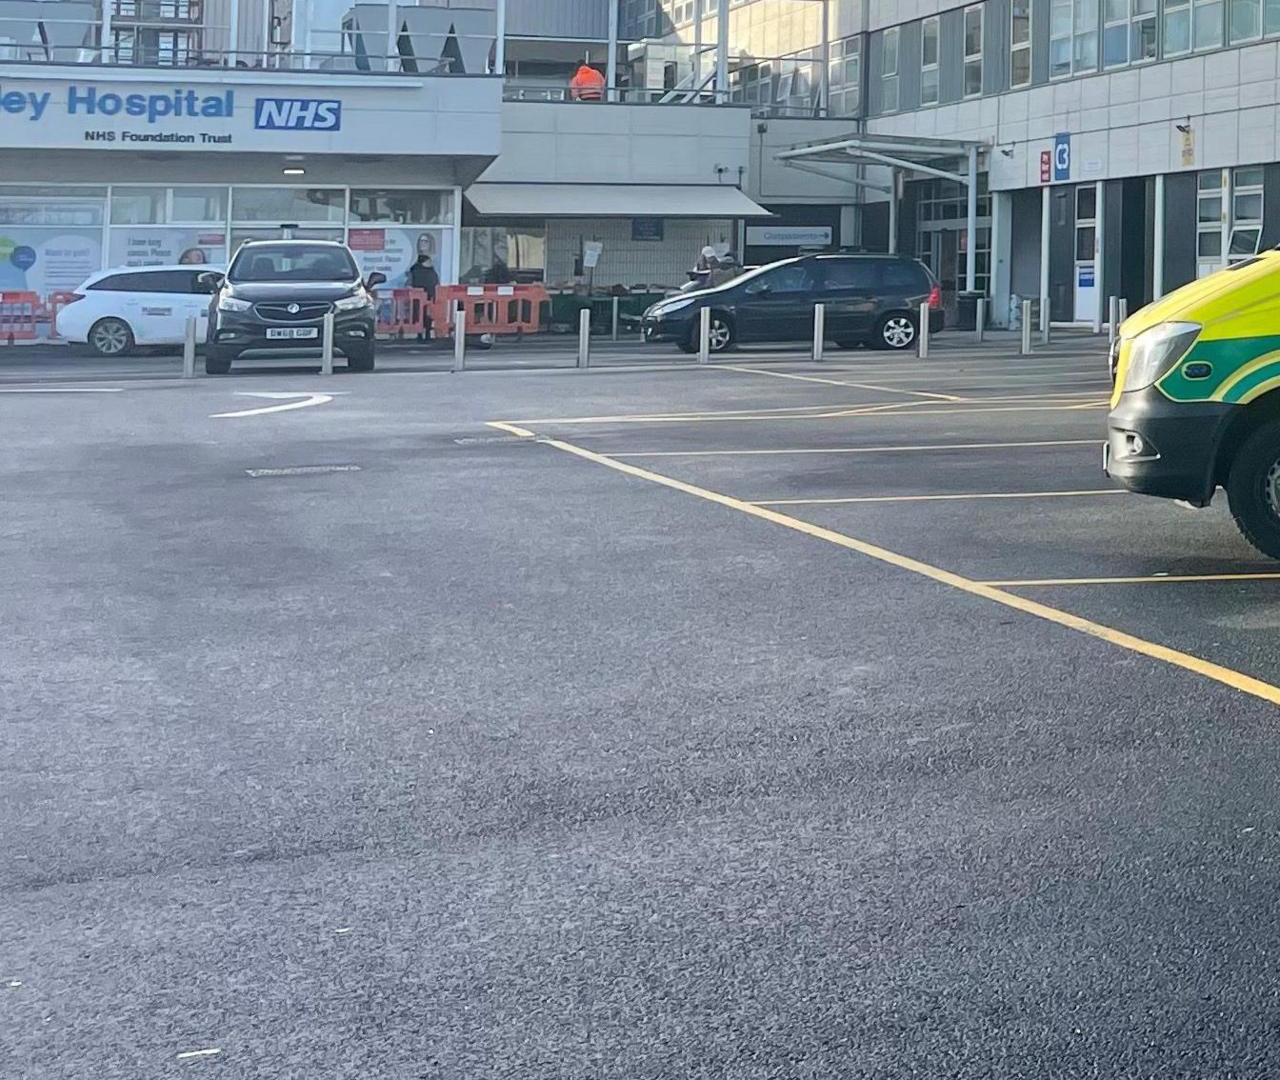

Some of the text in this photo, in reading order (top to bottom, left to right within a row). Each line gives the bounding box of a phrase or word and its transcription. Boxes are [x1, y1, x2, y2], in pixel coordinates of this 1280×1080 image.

[0, 83, 234, 123] ey Hospital
[258, 99, 341, 129] NHS
[84, 130, 233, 144] NHS Foundation Trust
